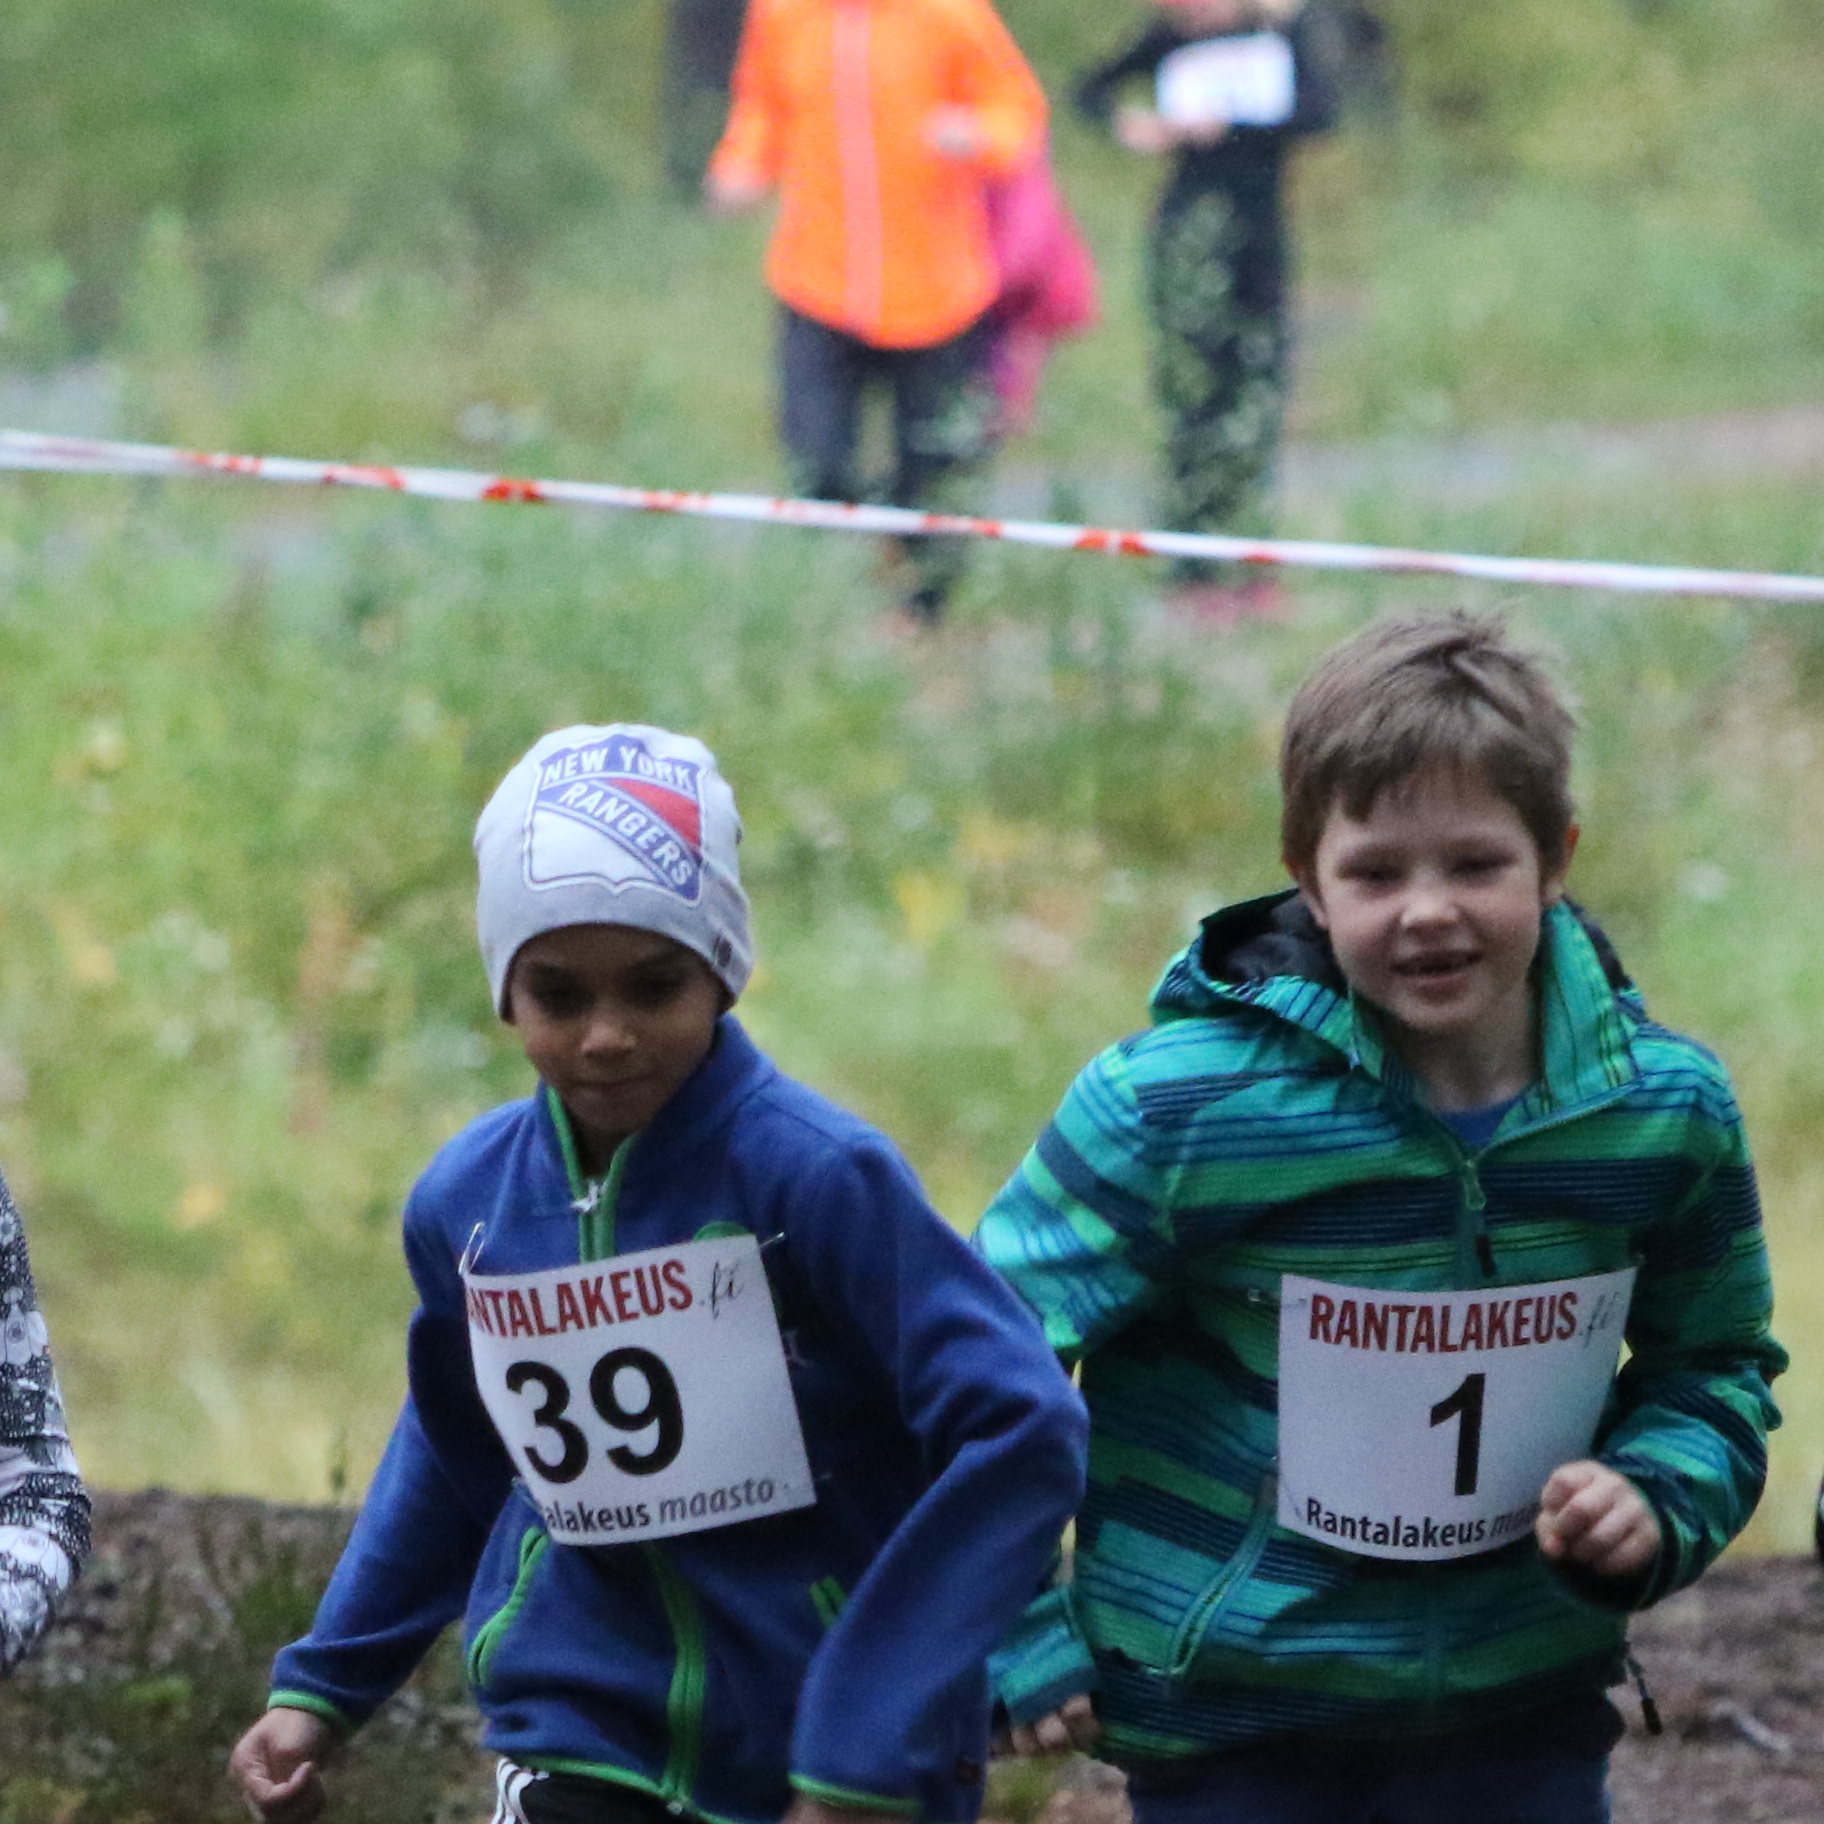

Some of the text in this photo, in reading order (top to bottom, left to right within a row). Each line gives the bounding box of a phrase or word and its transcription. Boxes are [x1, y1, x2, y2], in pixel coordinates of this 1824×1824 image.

[543, 746, 697, 793] NEW YORK
[558, 782, 693, 886] RANGERS
[505, 1346, 685, 1484] 39
[1429, 1373, 1486, 1496] 1
[659, 1477, 774, 1524] maasto
[1306, 1497, 1486, 1549] Rantalakeus
